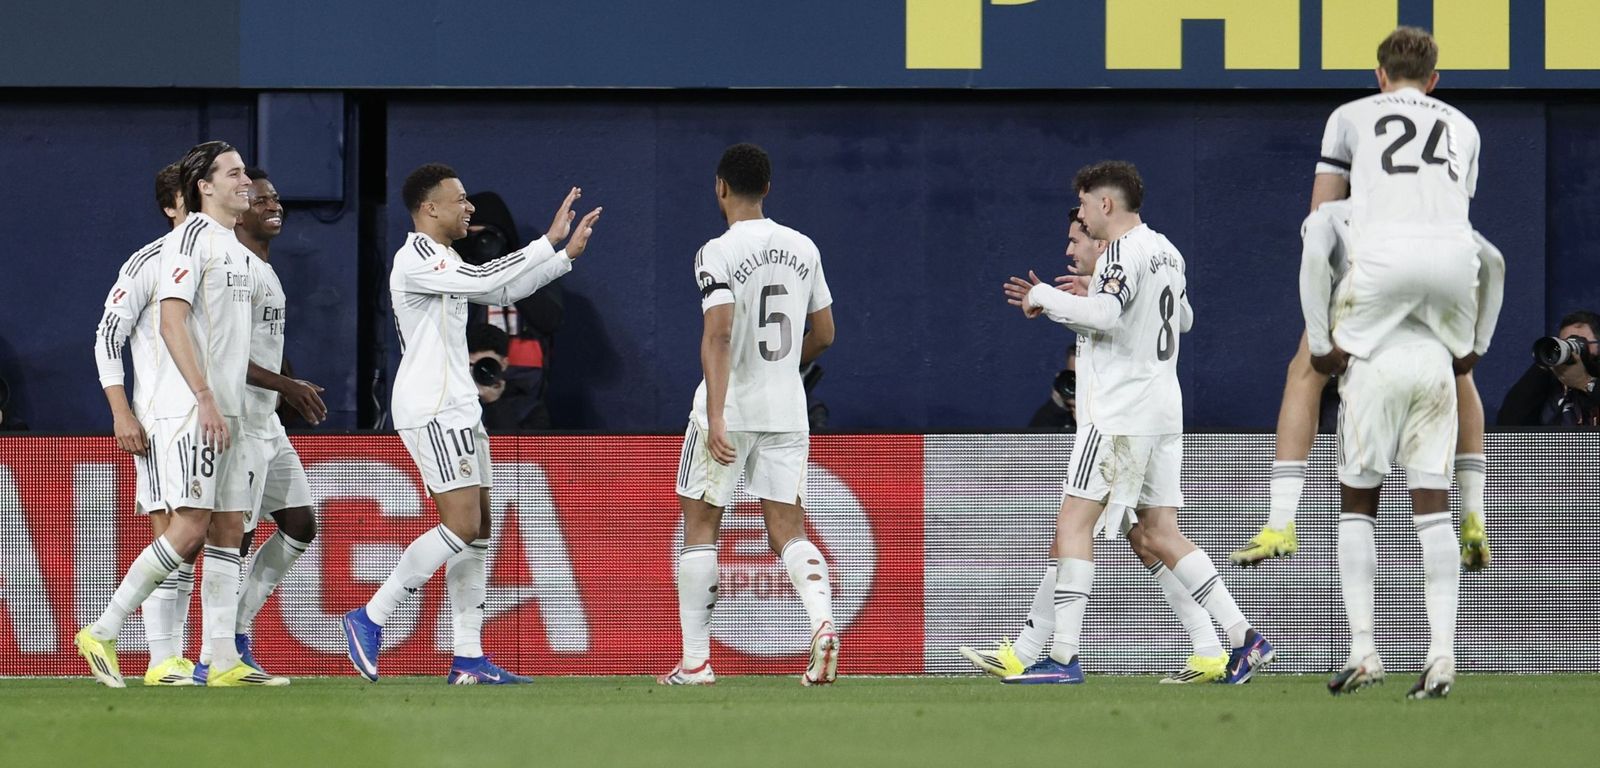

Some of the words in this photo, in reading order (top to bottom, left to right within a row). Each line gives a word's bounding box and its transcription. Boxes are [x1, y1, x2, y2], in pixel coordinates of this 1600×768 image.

[1374, 114, 1459, 182] 24
[733, 248, 810, 285] BELLINGHAM
[758, 284, 793, 362] 5
[1156, 285, 1176, 362] 8
[191, 445, 215, 478] 18
[446, 427, 475, 457] 10
